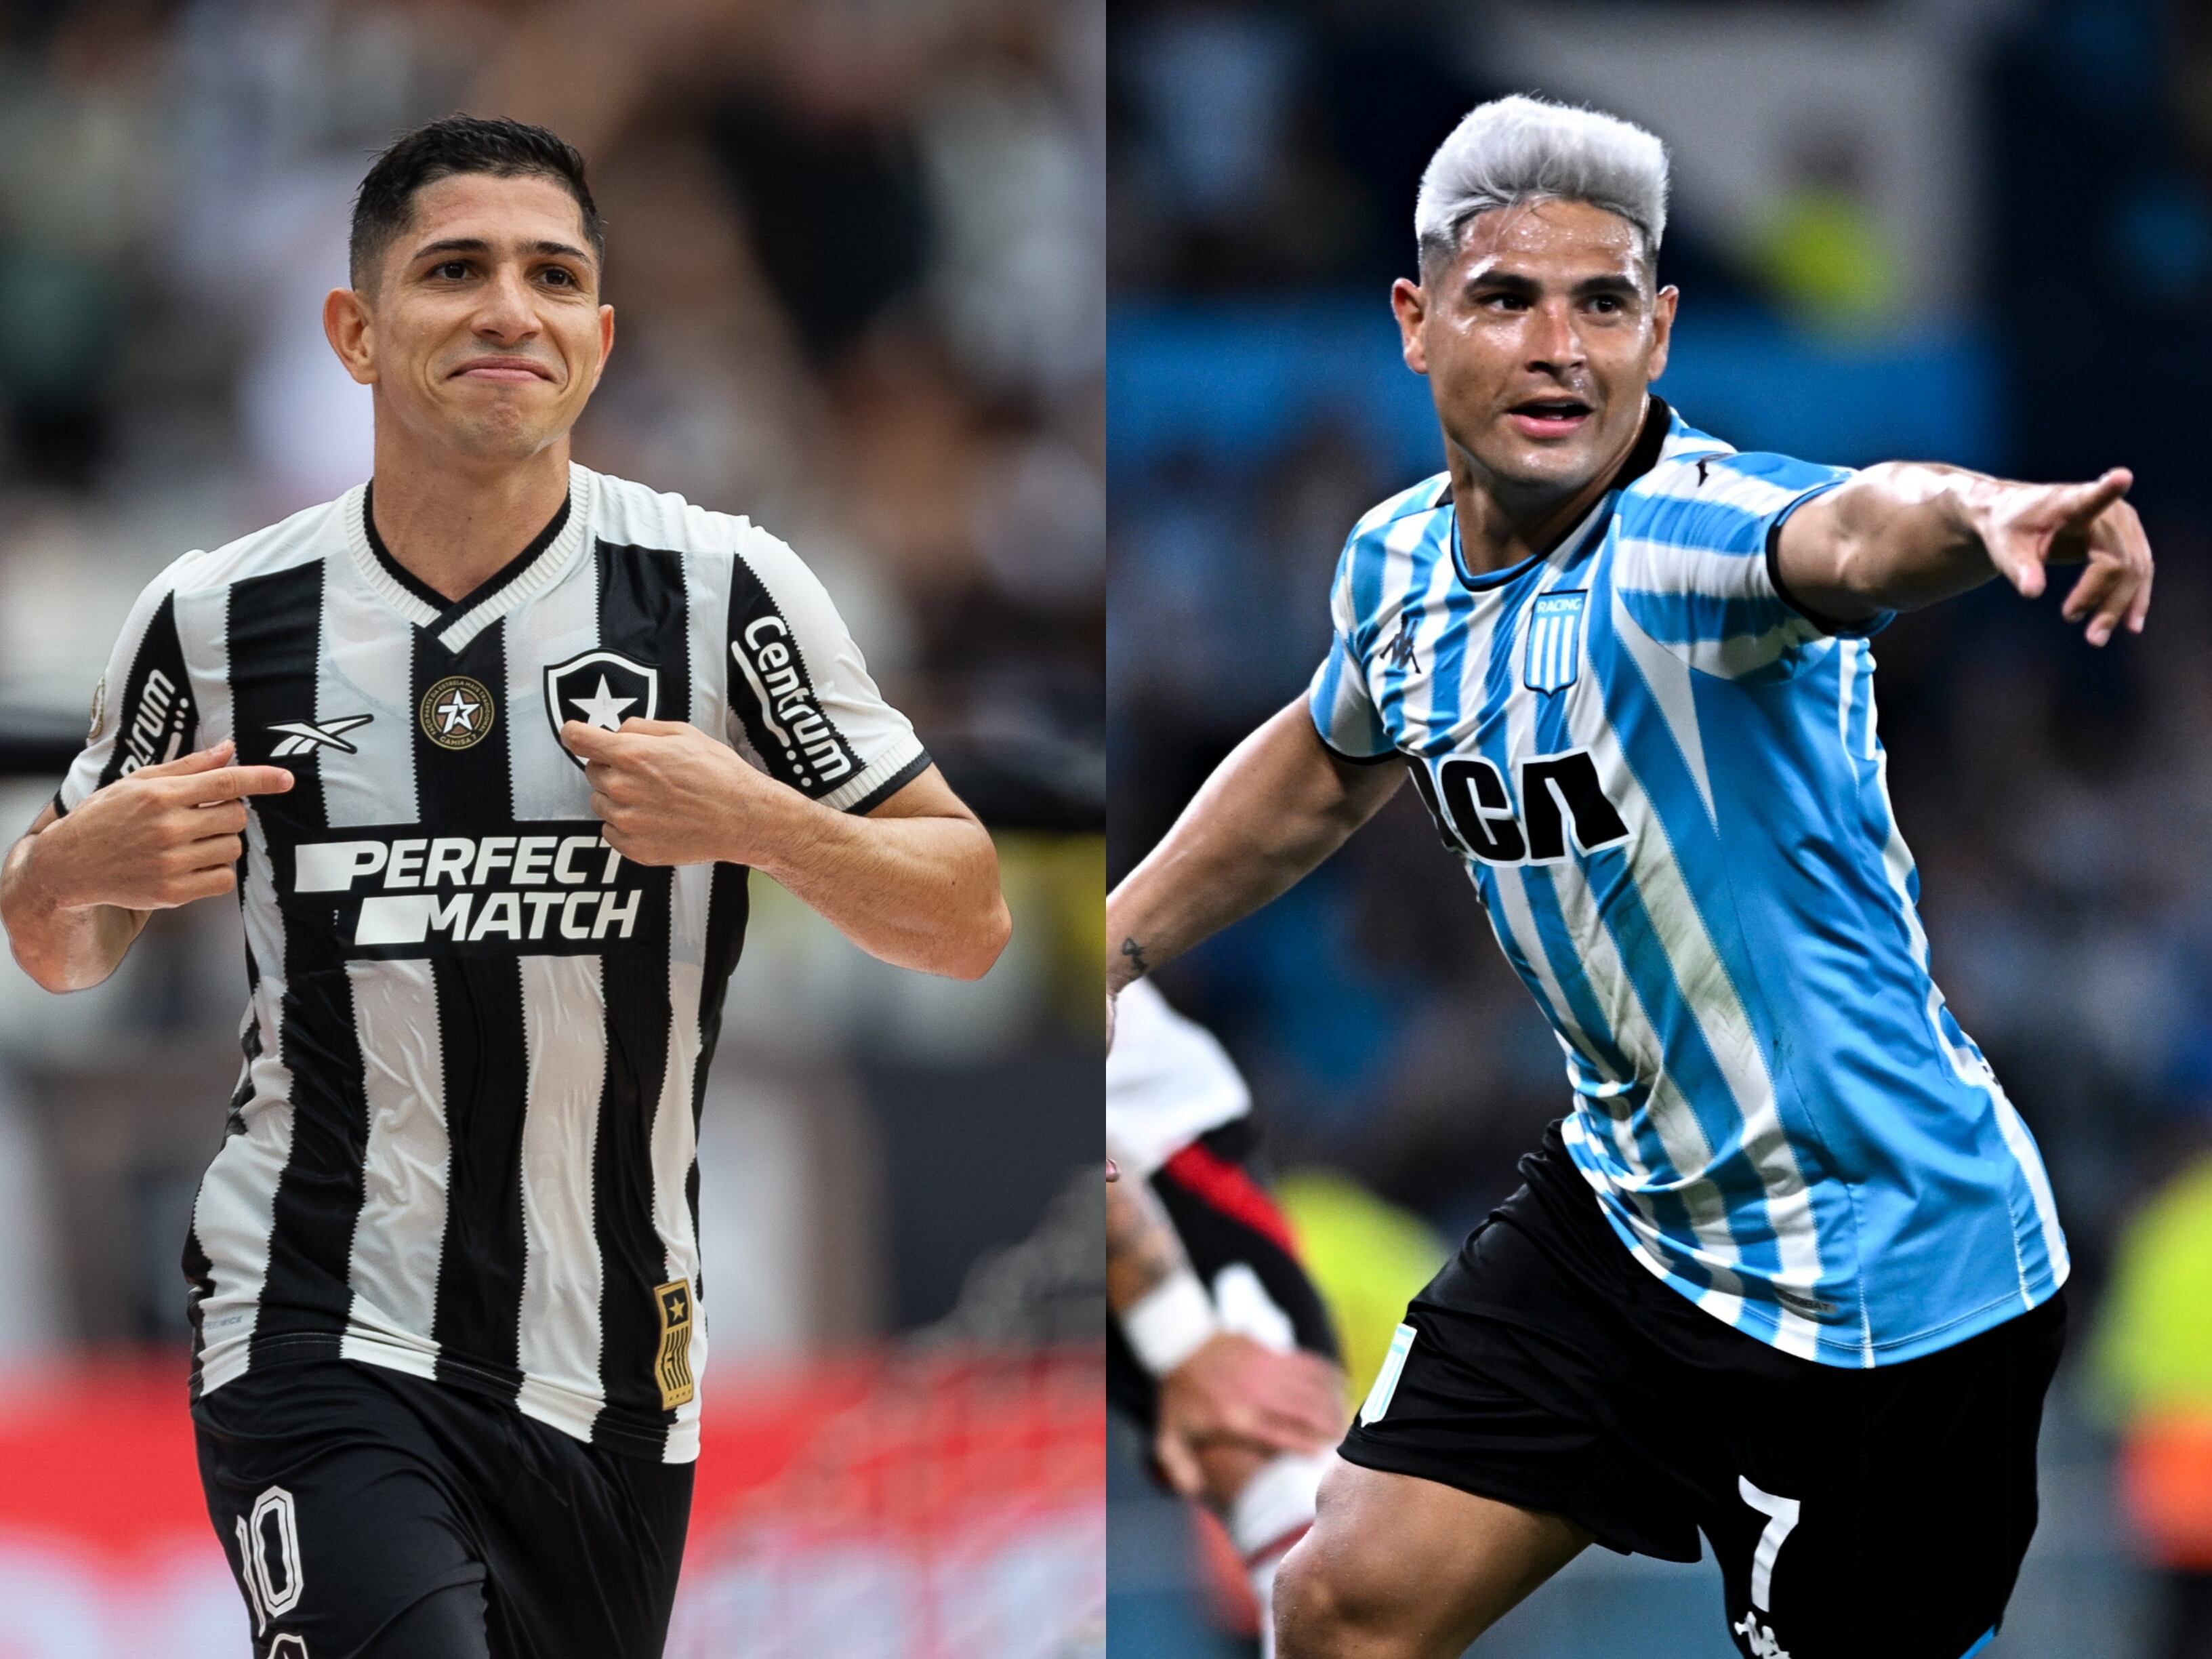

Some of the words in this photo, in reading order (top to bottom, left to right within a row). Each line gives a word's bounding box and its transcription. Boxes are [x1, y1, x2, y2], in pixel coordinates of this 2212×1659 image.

[1537, 598, 1582, 613] RACING
[119, 669, 176, 778] ntrum
[745, 616, 851, 781] Centrum
[439, 736, 472, 745] CAMISA
[337, 836, 621, 890] PERFECT
[417, 890, 642, 942] MATCH
[235, 1485, 304, 1637] 10
[1738, 1475, 1801, 1612] 7
